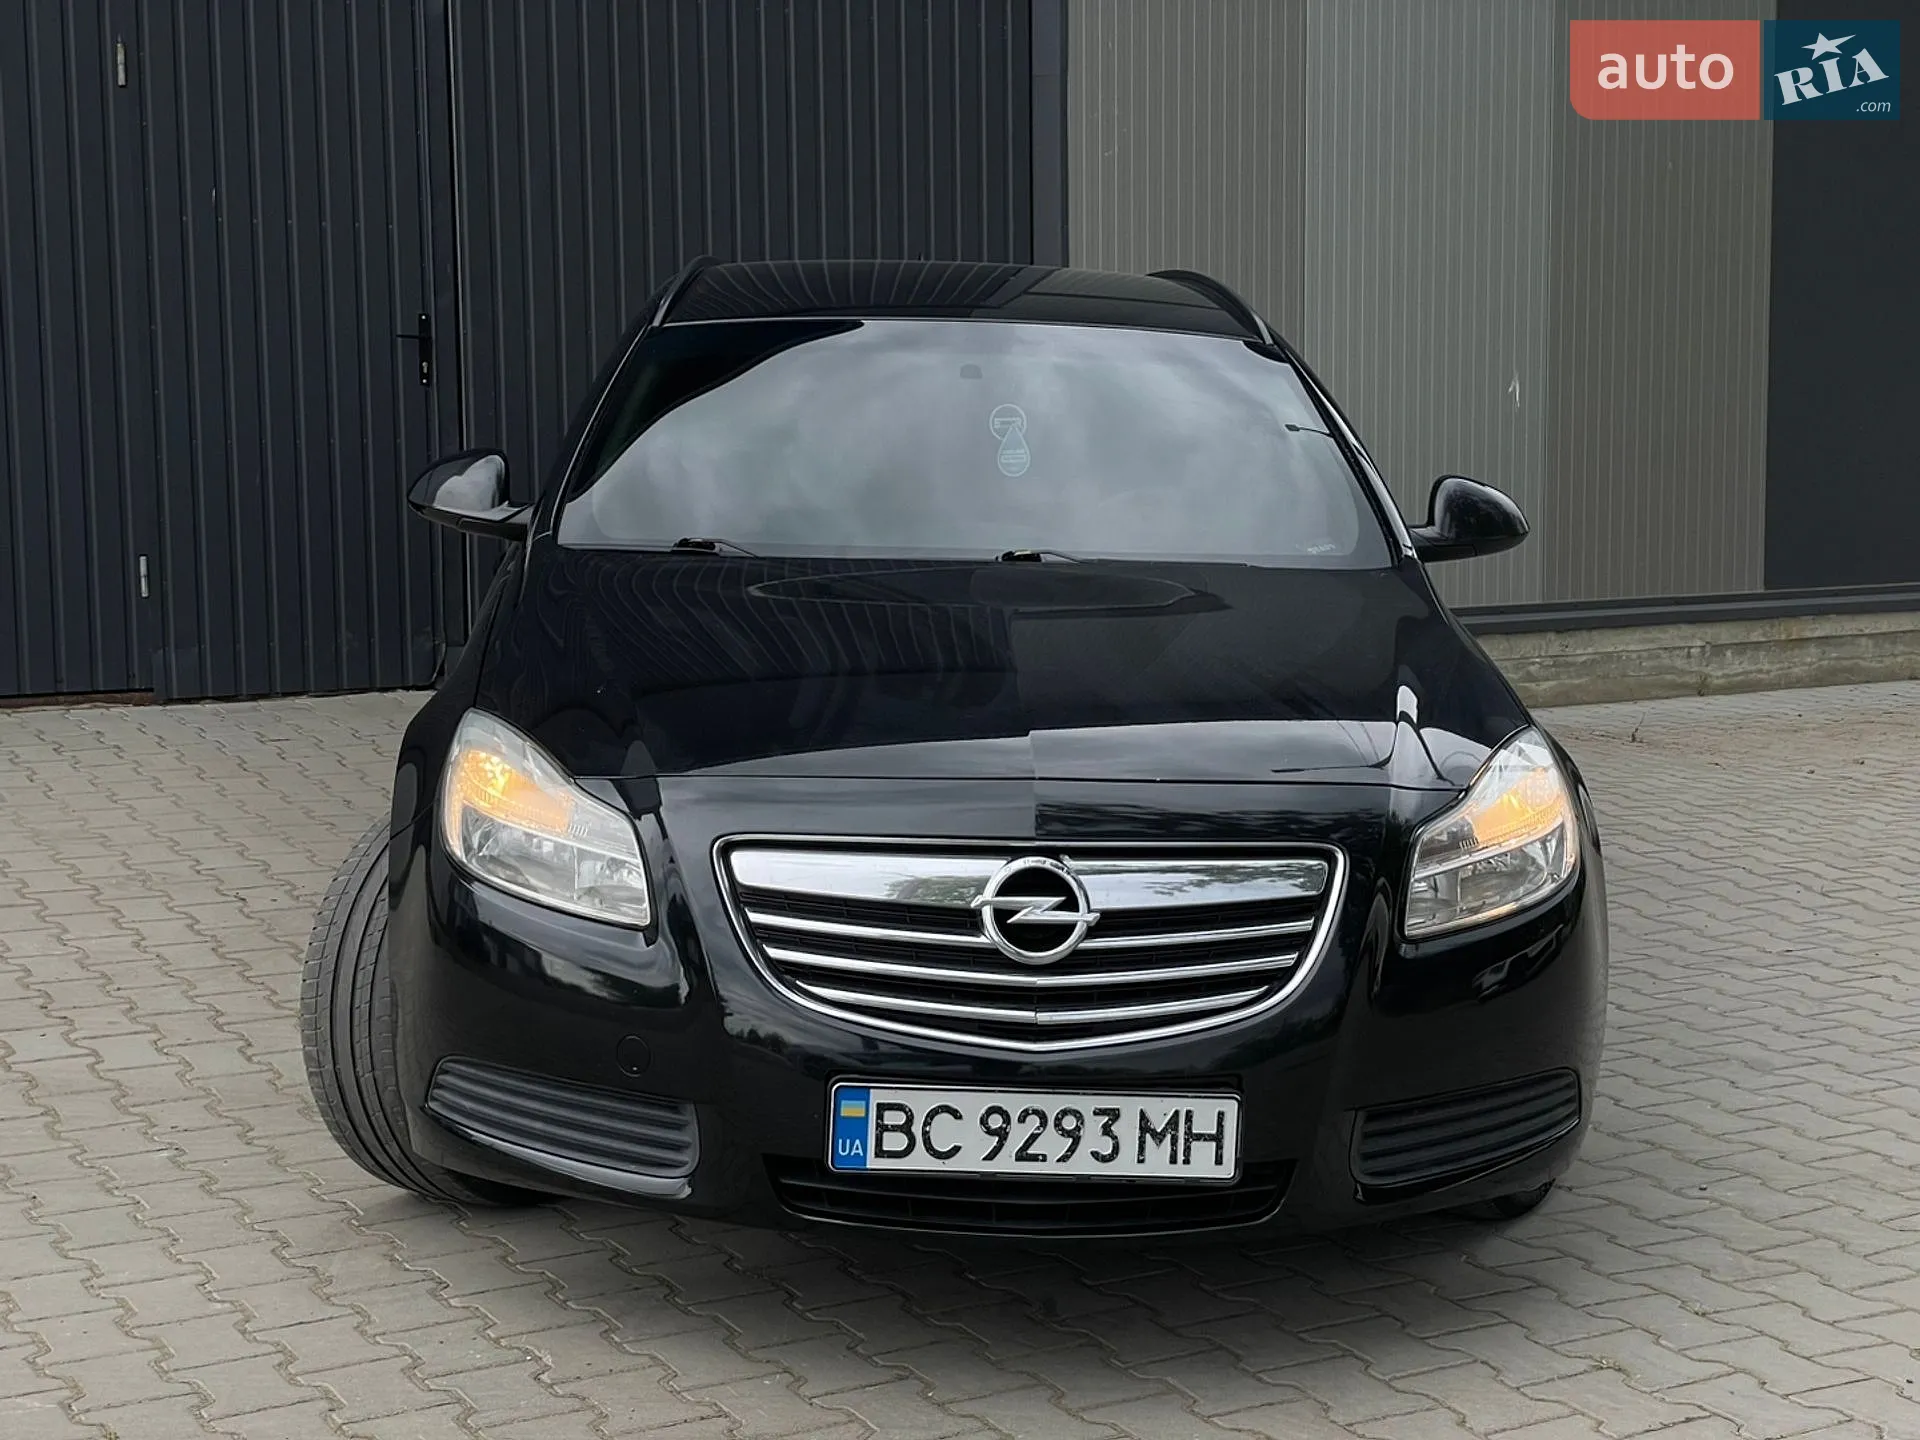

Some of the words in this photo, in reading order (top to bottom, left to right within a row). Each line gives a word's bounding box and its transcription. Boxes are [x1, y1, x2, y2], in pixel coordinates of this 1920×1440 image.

[838, 1139, 865, 1158] UA
[873, 1101, 963, 1160] BC
[979, 1105, 1122, 1164] 9293
[1136, 1107, 1226, 1166] MH
